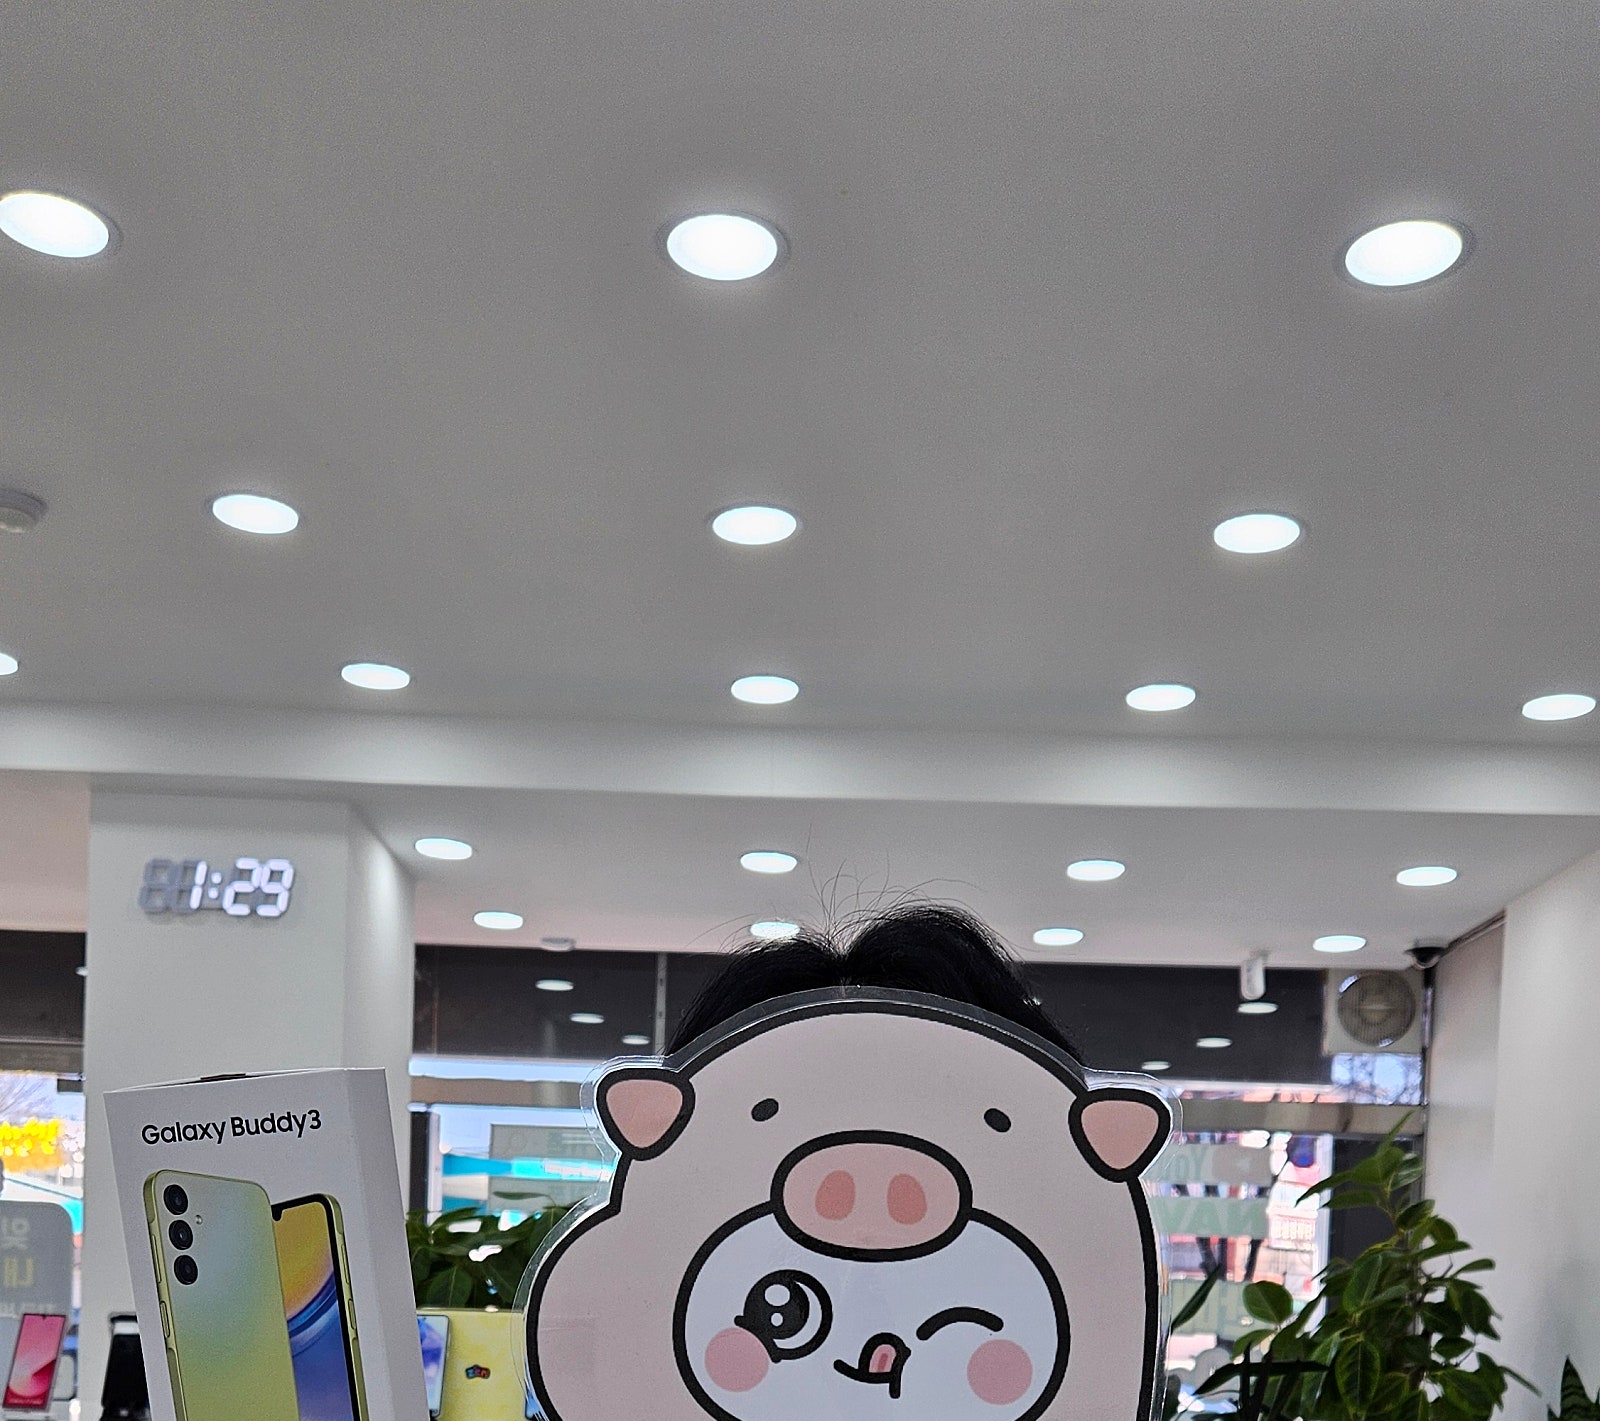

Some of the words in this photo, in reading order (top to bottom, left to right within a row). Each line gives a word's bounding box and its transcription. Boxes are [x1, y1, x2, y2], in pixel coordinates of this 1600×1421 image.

[189, 857, 295, 917] 1:29
[141, 1121, 226, 1145] Galaxy
[230, 1109, 322, 1138] Buddy3
